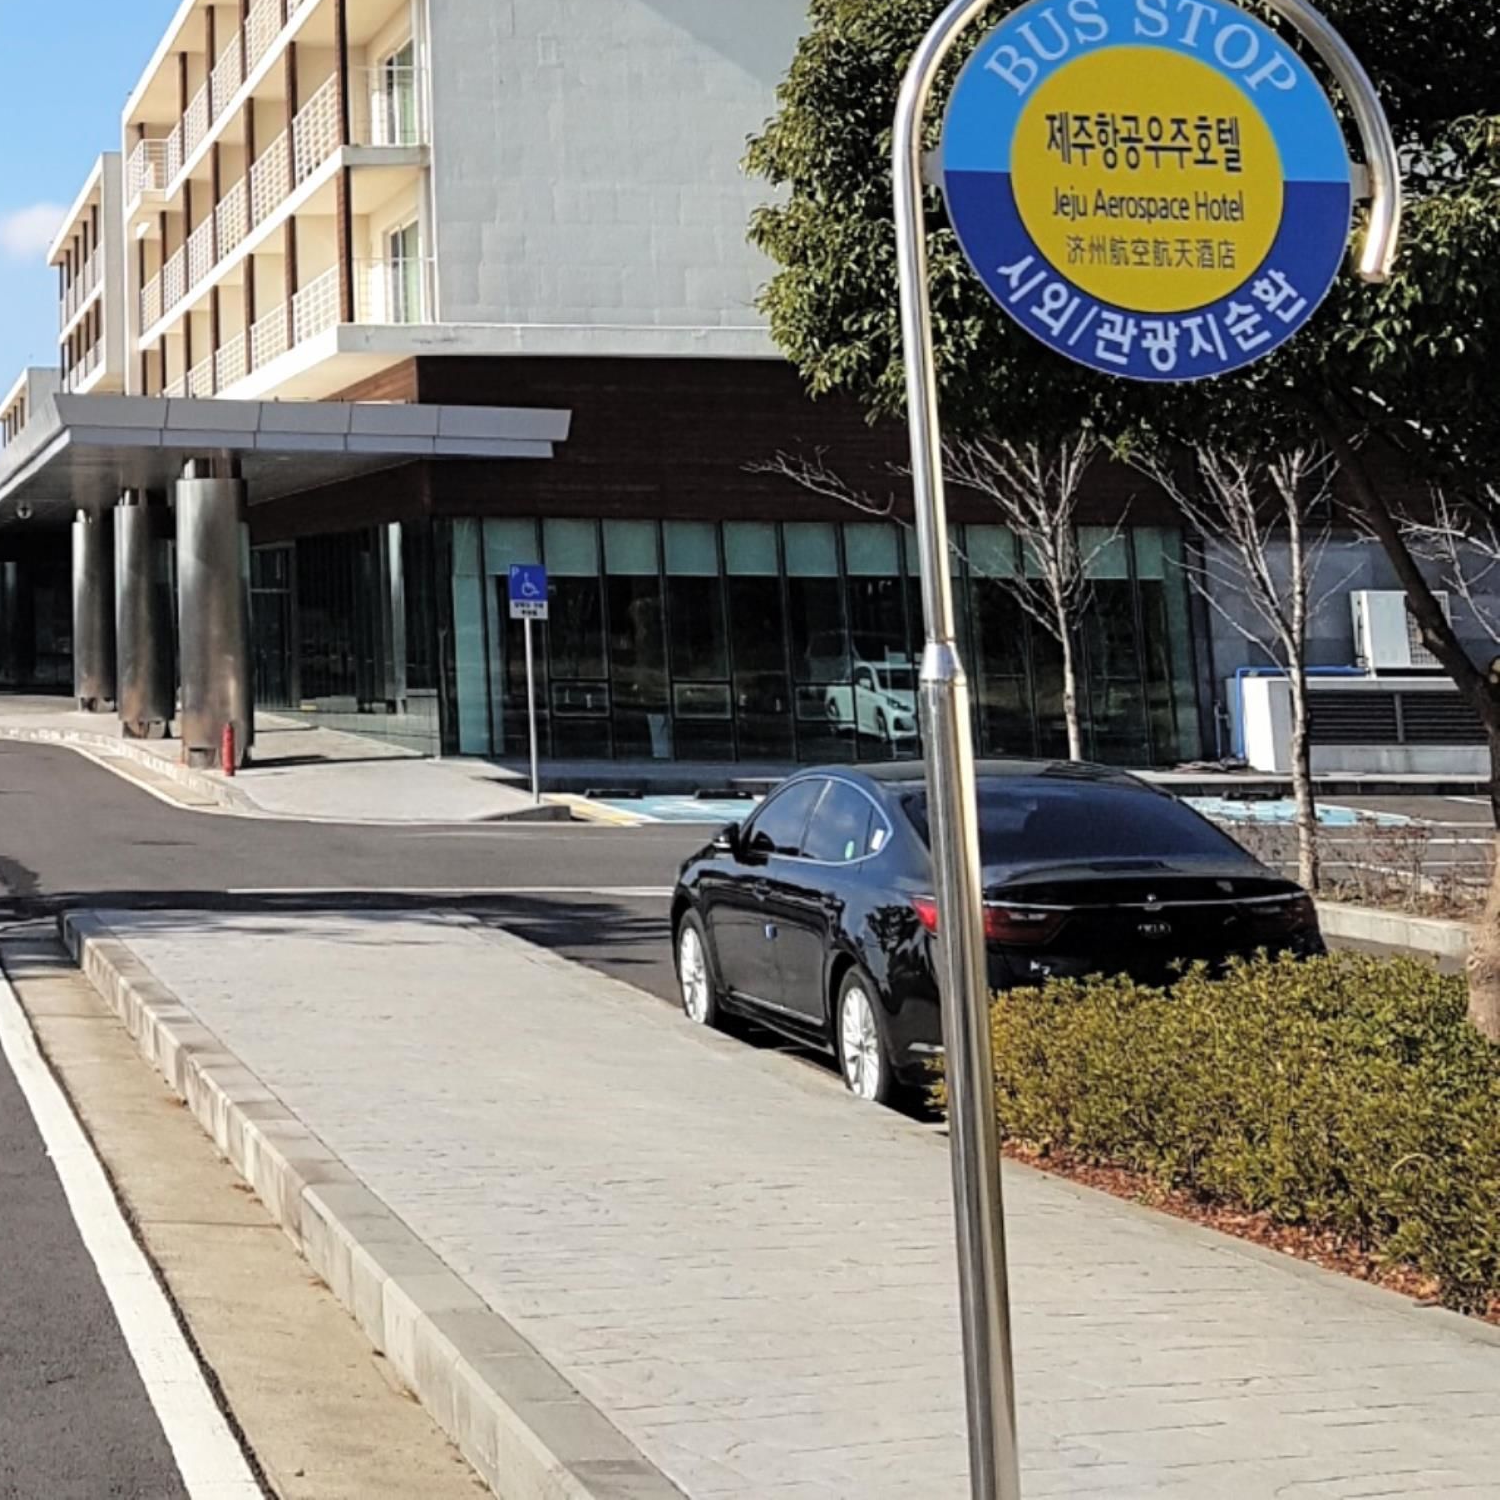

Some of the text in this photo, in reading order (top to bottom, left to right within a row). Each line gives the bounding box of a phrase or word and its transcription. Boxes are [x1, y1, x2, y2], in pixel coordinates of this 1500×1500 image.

[1045, 111, 1242, 173] 제주항공우주호텔
[1053, 185, 1245, 224] Jeju Aerospace Hotel
[1066, 235, 1237, 269] 济州航空航天酒店
